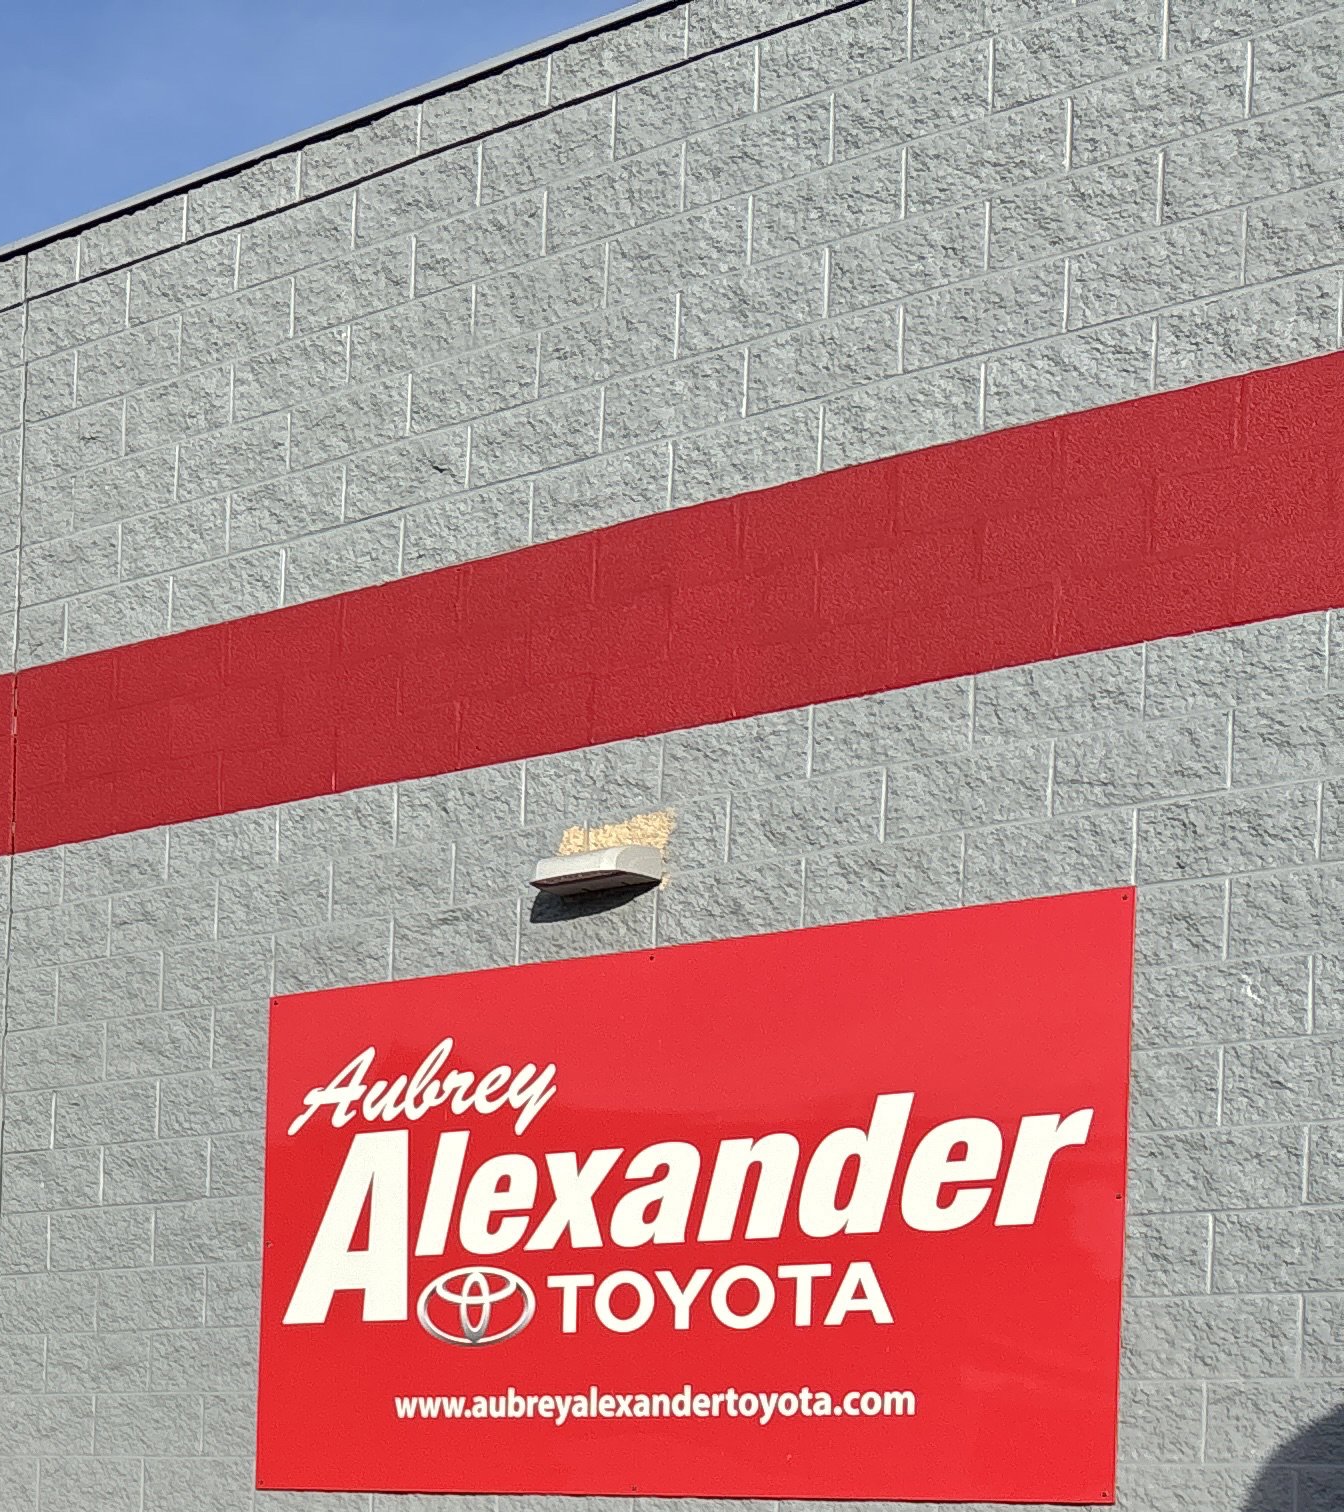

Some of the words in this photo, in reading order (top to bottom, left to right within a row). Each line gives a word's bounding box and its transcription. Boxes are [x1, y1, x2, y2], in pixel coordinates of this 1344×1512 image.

[287, 1037, 557, 1136] Aubrey
[282, 1091, 1094, 1325] Alexander
[547, 1261, 894, 1333] TOYOTA
[394, 1384, 916, 1426] www.aubreyalexandertoyota.com
